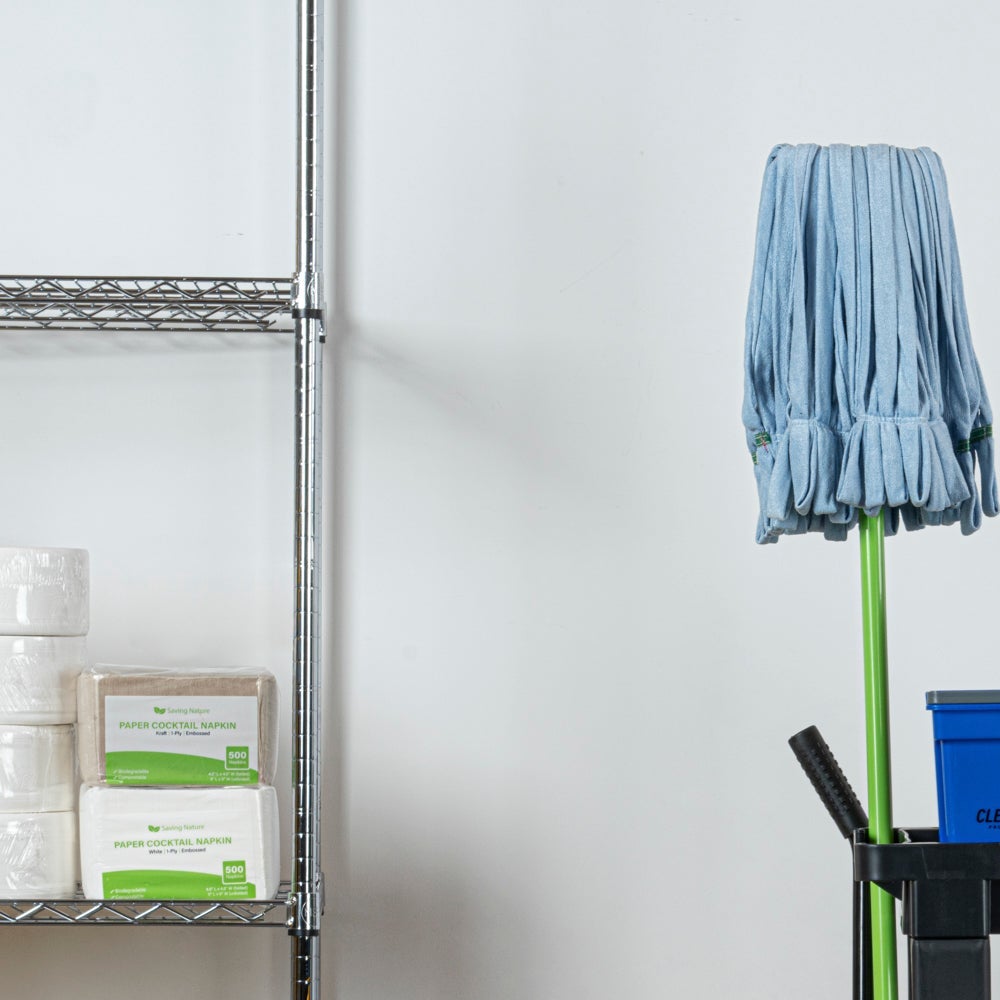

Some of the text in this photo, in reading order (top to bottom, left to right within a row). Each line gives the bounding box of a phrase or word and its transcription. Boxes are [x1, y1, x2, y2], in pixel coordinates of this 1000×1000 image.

[167, 707, 188, 715] Saving
[119, 721, 237, 729] PAPER COCKTAIL NAPKIN
[228, 751, 247, 760] 500
[114, 836, 232, 849] PAPER COCKTAIL NAPKIN
[225, 865, 243, 874] 500
